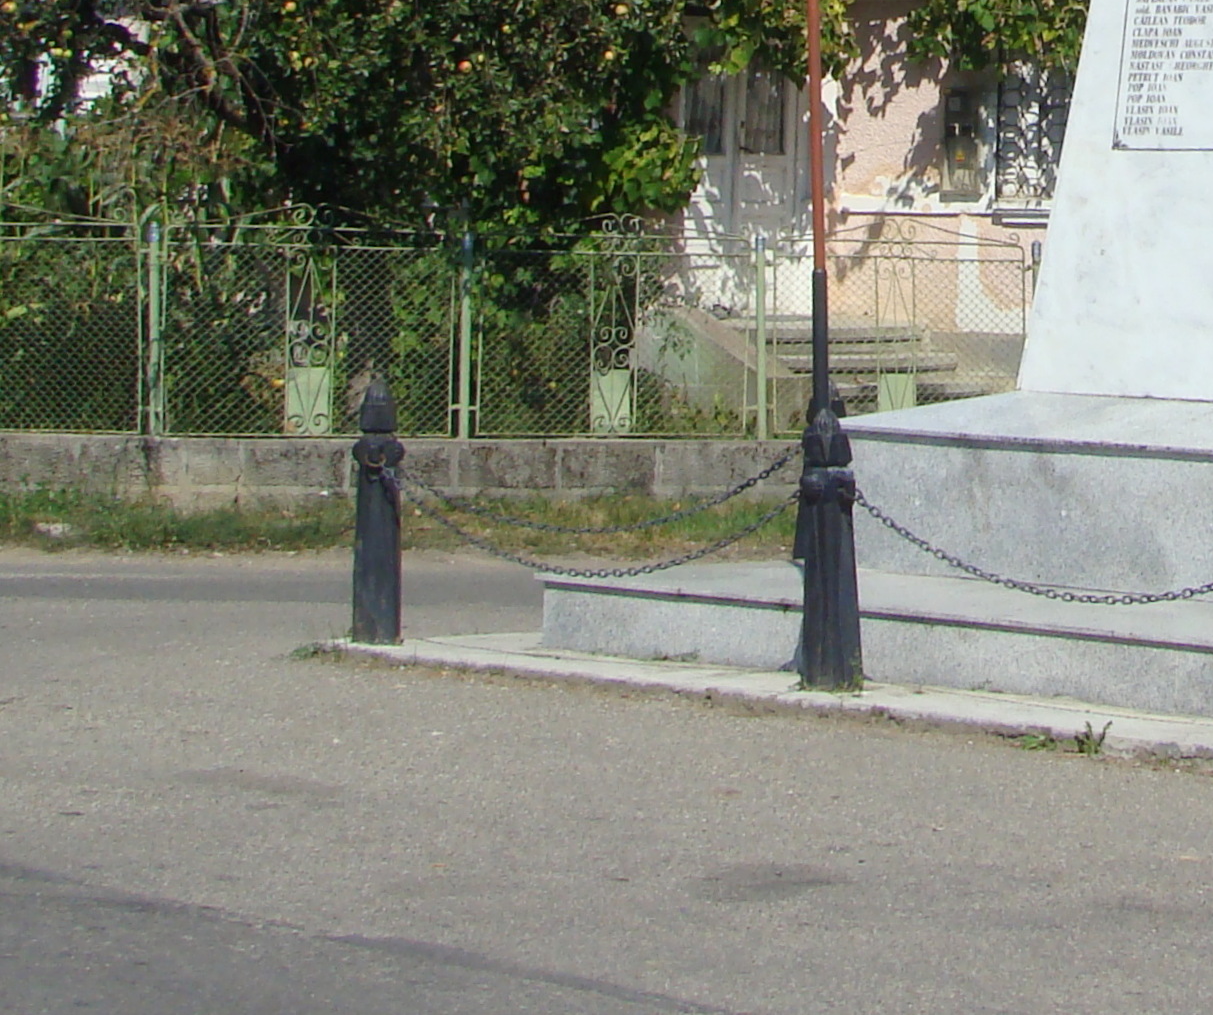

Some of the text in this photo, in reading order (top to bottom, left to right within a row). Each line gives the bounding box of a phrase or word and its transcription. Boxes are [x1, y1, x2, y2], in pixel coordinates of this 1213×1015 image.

[1163, 28, 1183, 37] IOAN
[1128, 83, 1166, 92] POP IOAN
[1127, 94, 1166, 103] POP IOAN
[1158, 106, 1178, 114] IOAN
[1155, 127, 1183, 136] VASILE
